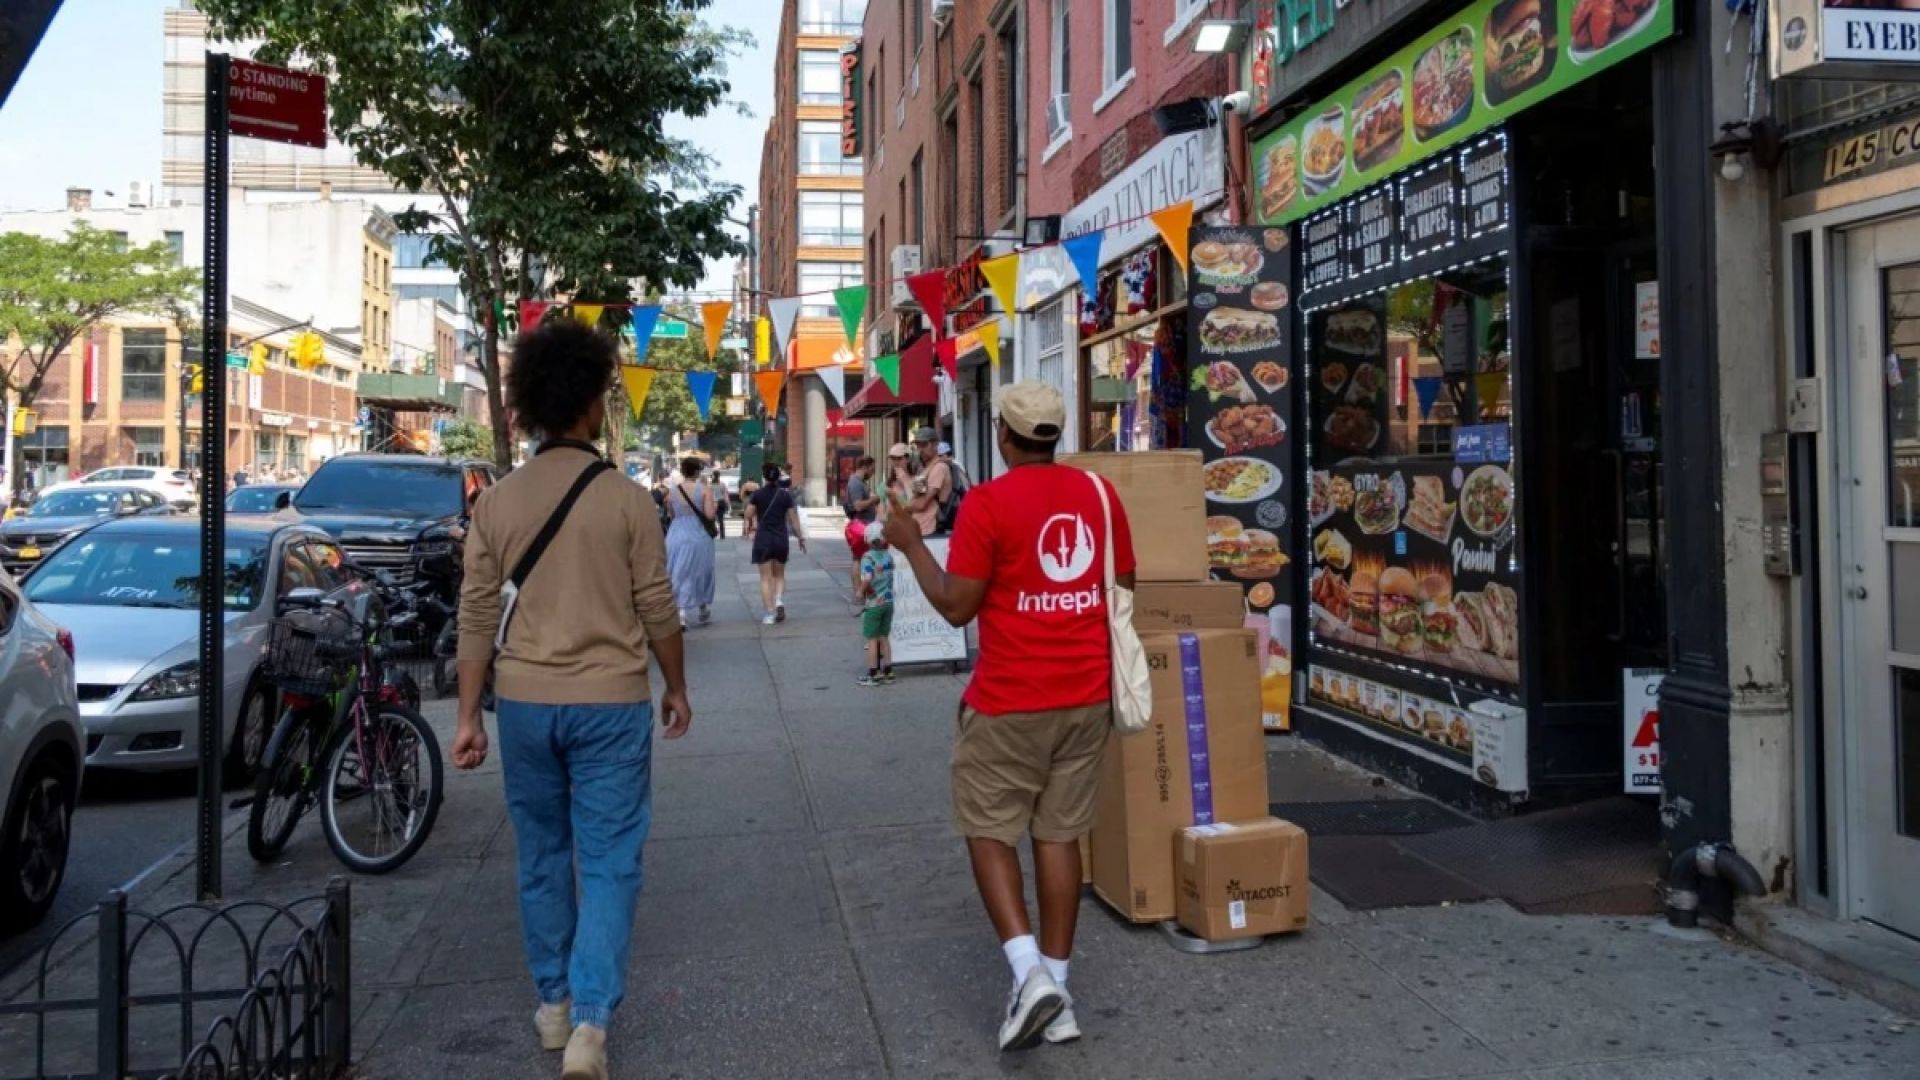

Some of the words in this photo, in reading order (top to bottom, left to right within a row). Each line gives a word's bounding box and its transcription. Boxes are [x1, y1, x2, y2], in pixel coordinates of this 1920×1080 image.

[1846, 21, 1920, 51] EYEB
[230, 66, 240, 80] O
[243, 68, 308, 91] STANDING
[230, 86, 275, 104] nytime
[1830, 134, 1877, 177] 145
[1114, 134, 1200, 237] VINTAGE
[1362, 217, 1390, 246] SALAD
[1417, 206, 1448, 239] VAPES
[1452, 536, 1497, 576] Panini
[1017, 583, 1100, 615] Intrepi
[1638, 753, 1658, 767] $1
